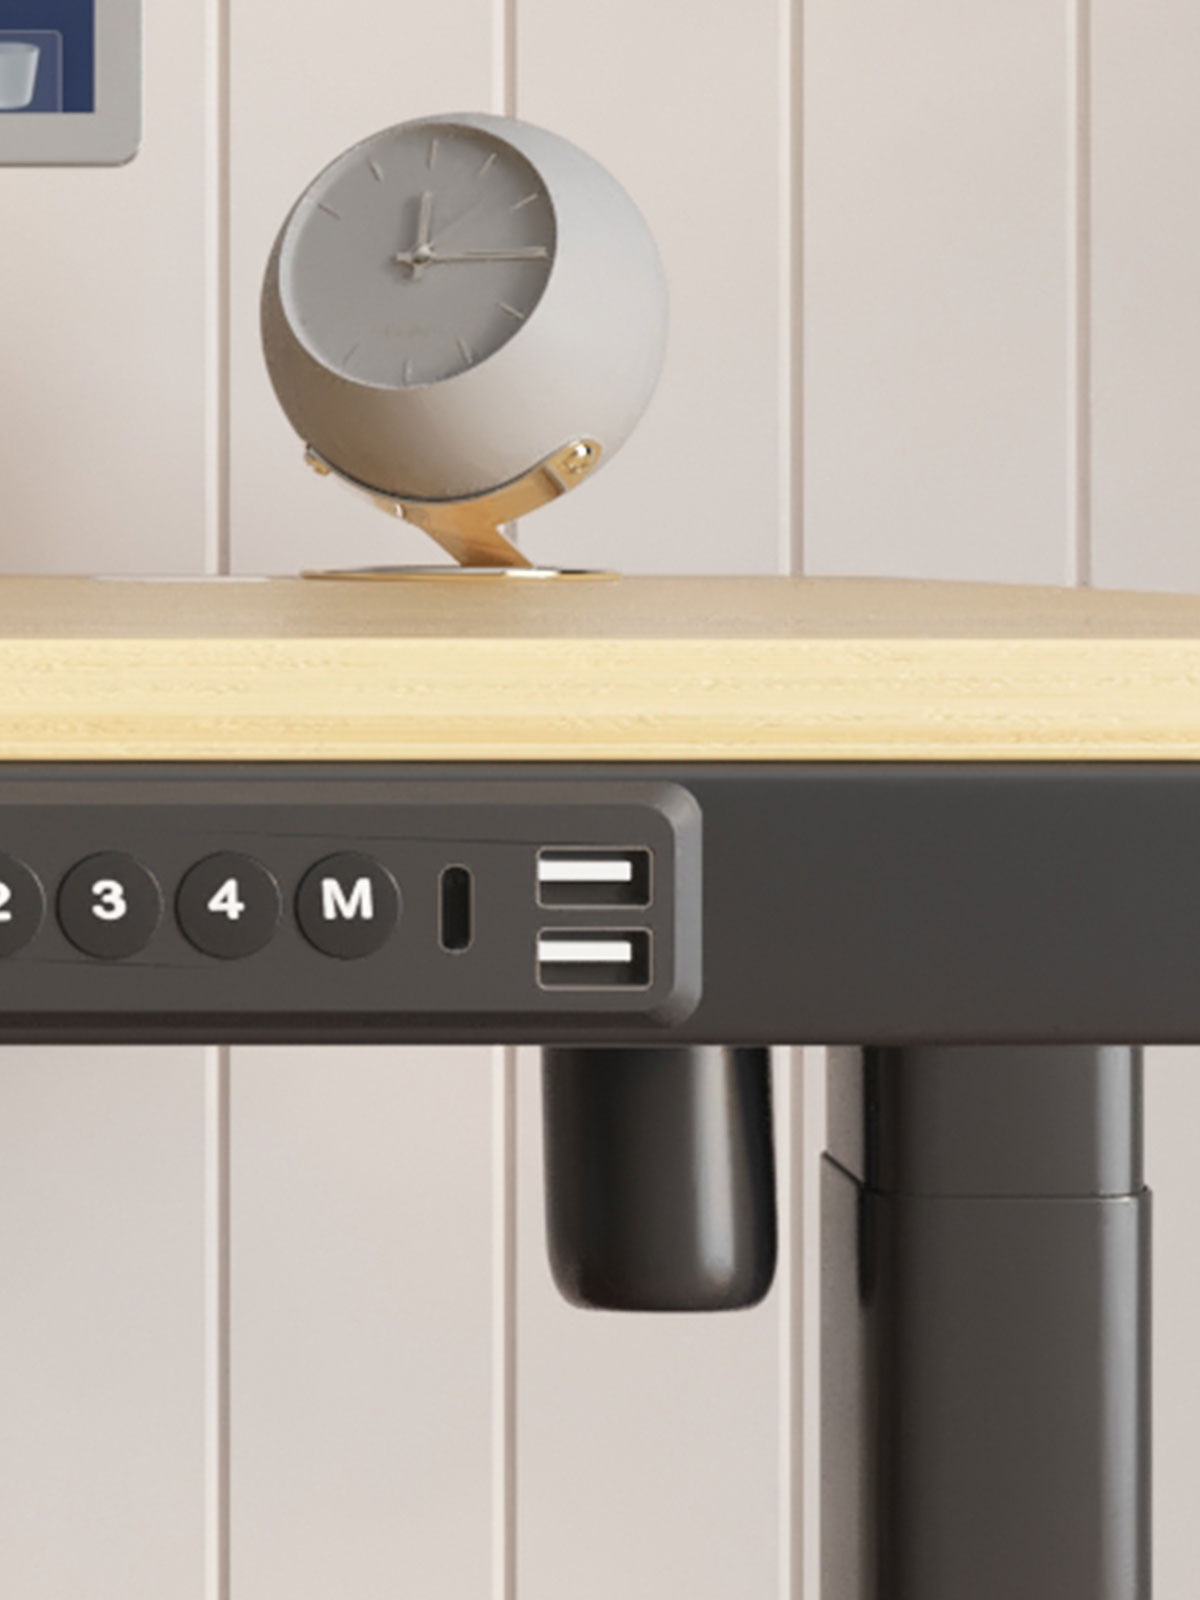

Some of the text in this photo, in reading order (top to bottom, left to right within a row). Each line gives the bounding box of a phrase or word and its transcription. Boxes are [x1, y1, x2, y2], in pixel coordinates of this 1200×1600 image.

[92, 879, 127, 921] 3
[207, 878, 245, 920] 4
[321, 877, 374, 920] M
